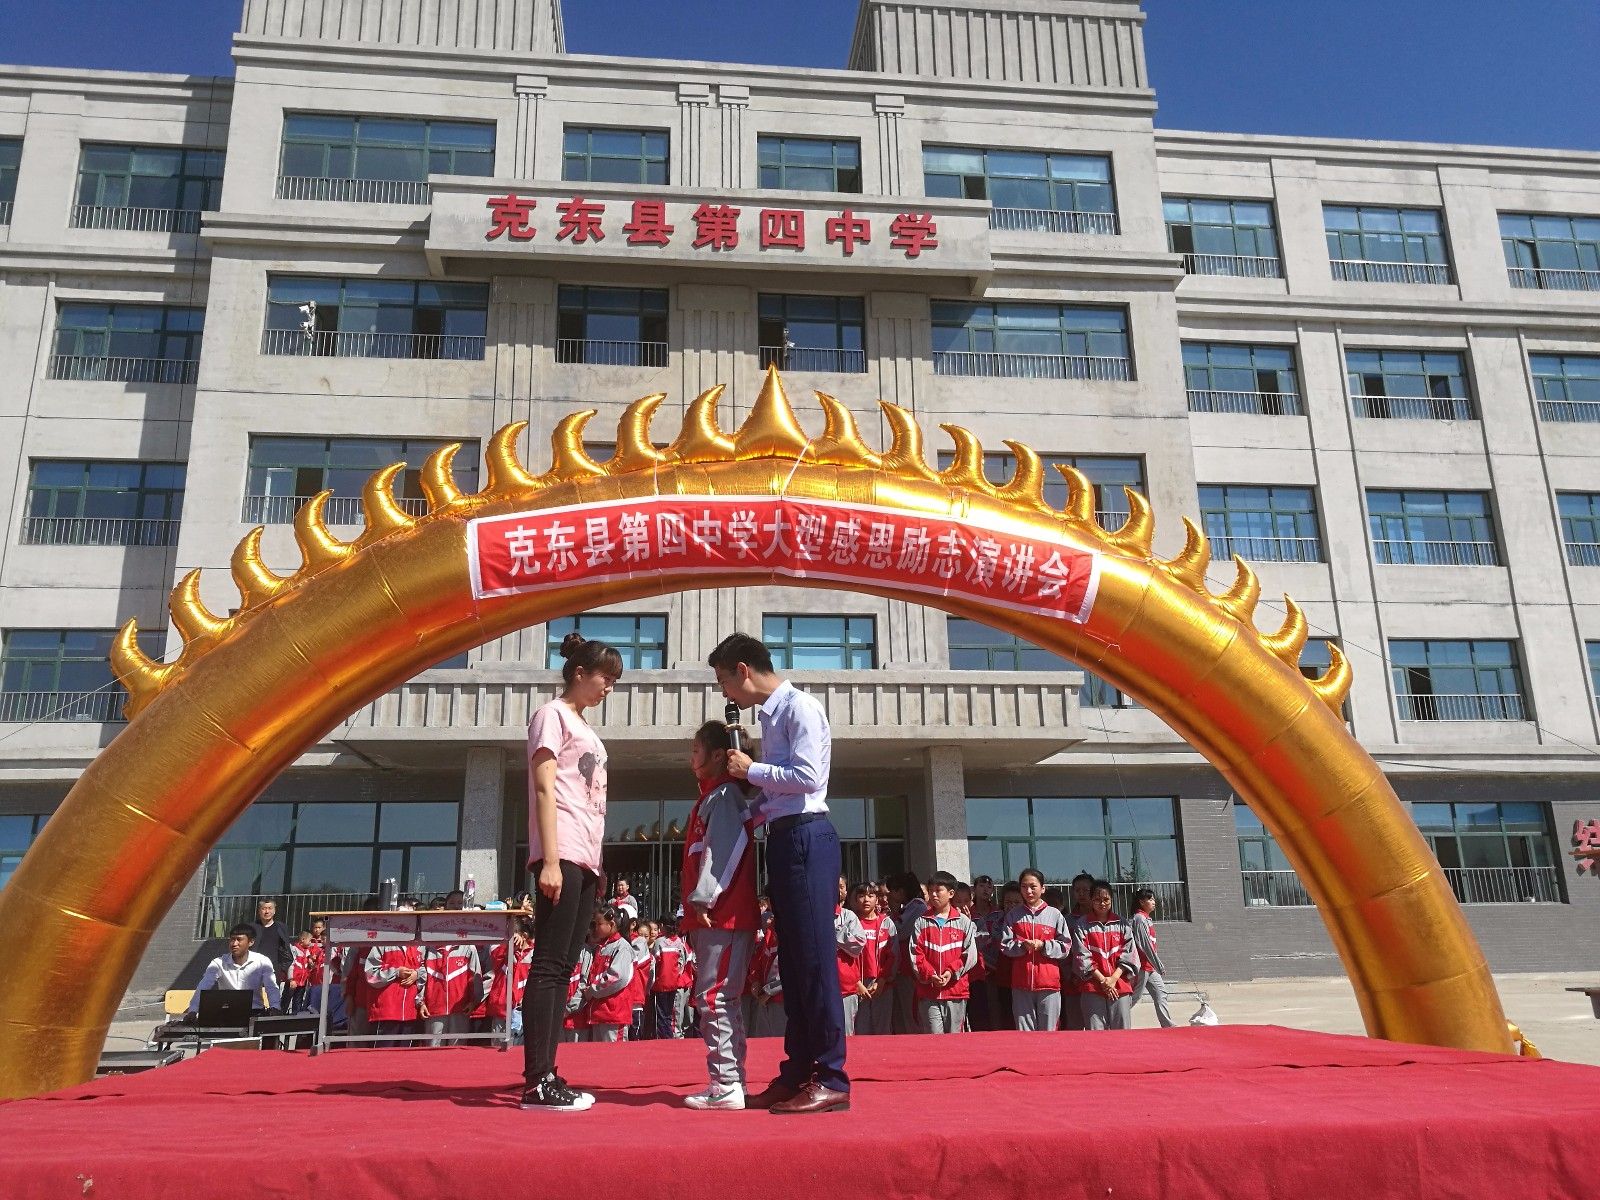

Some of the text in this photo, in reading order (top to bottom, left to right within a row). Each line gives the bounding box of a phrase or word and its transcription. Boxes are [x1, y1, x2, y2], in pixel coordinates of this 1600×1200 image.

[486, 193, 938, 257] 克东县第四中学
[503, 510, 1072, 600] 克东县第四中学大型感恩励志演讲会
